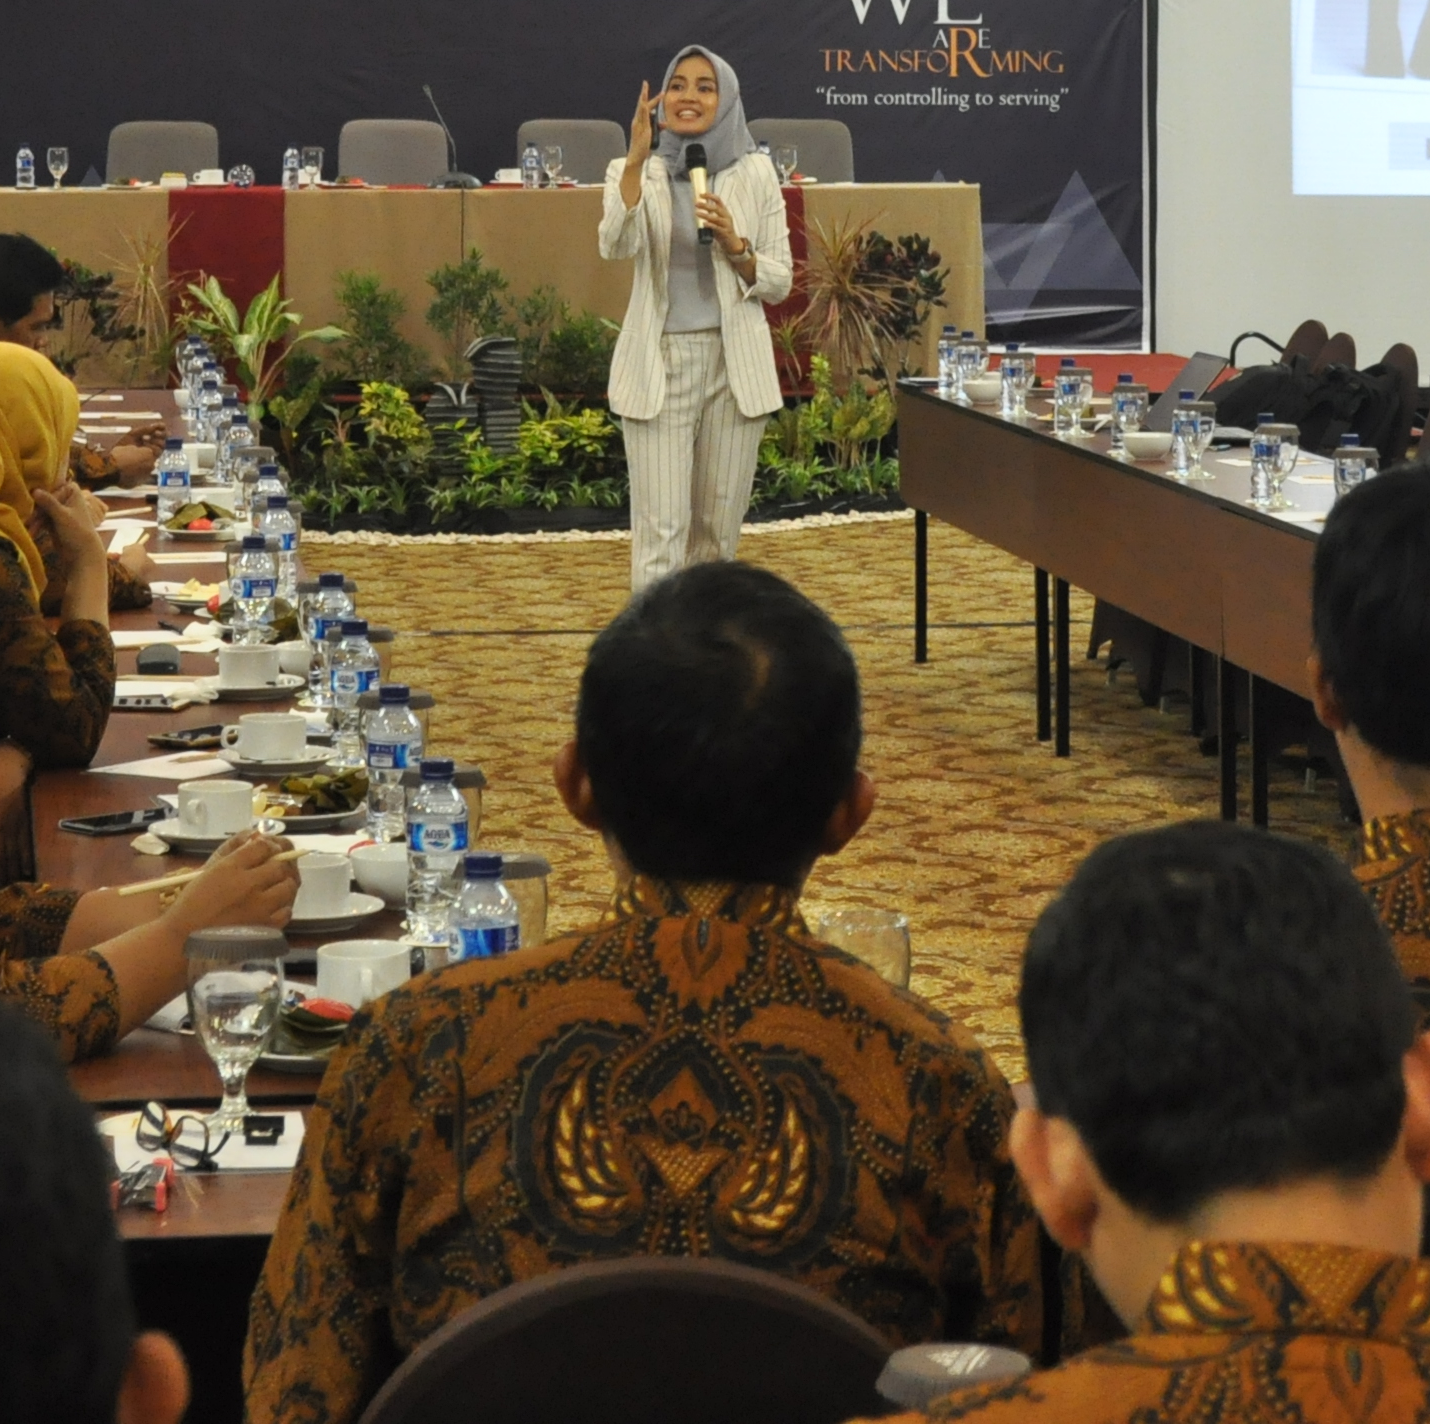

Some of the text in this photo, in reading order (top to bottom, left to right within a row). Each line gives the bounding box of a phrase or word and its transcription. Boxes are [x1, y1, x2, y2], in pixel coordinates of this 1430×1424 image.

[820, 27, 1065, 78] TRANSFORMING
[873, 86, 970, 113] controlling
[975, 92, 994, 106] to
